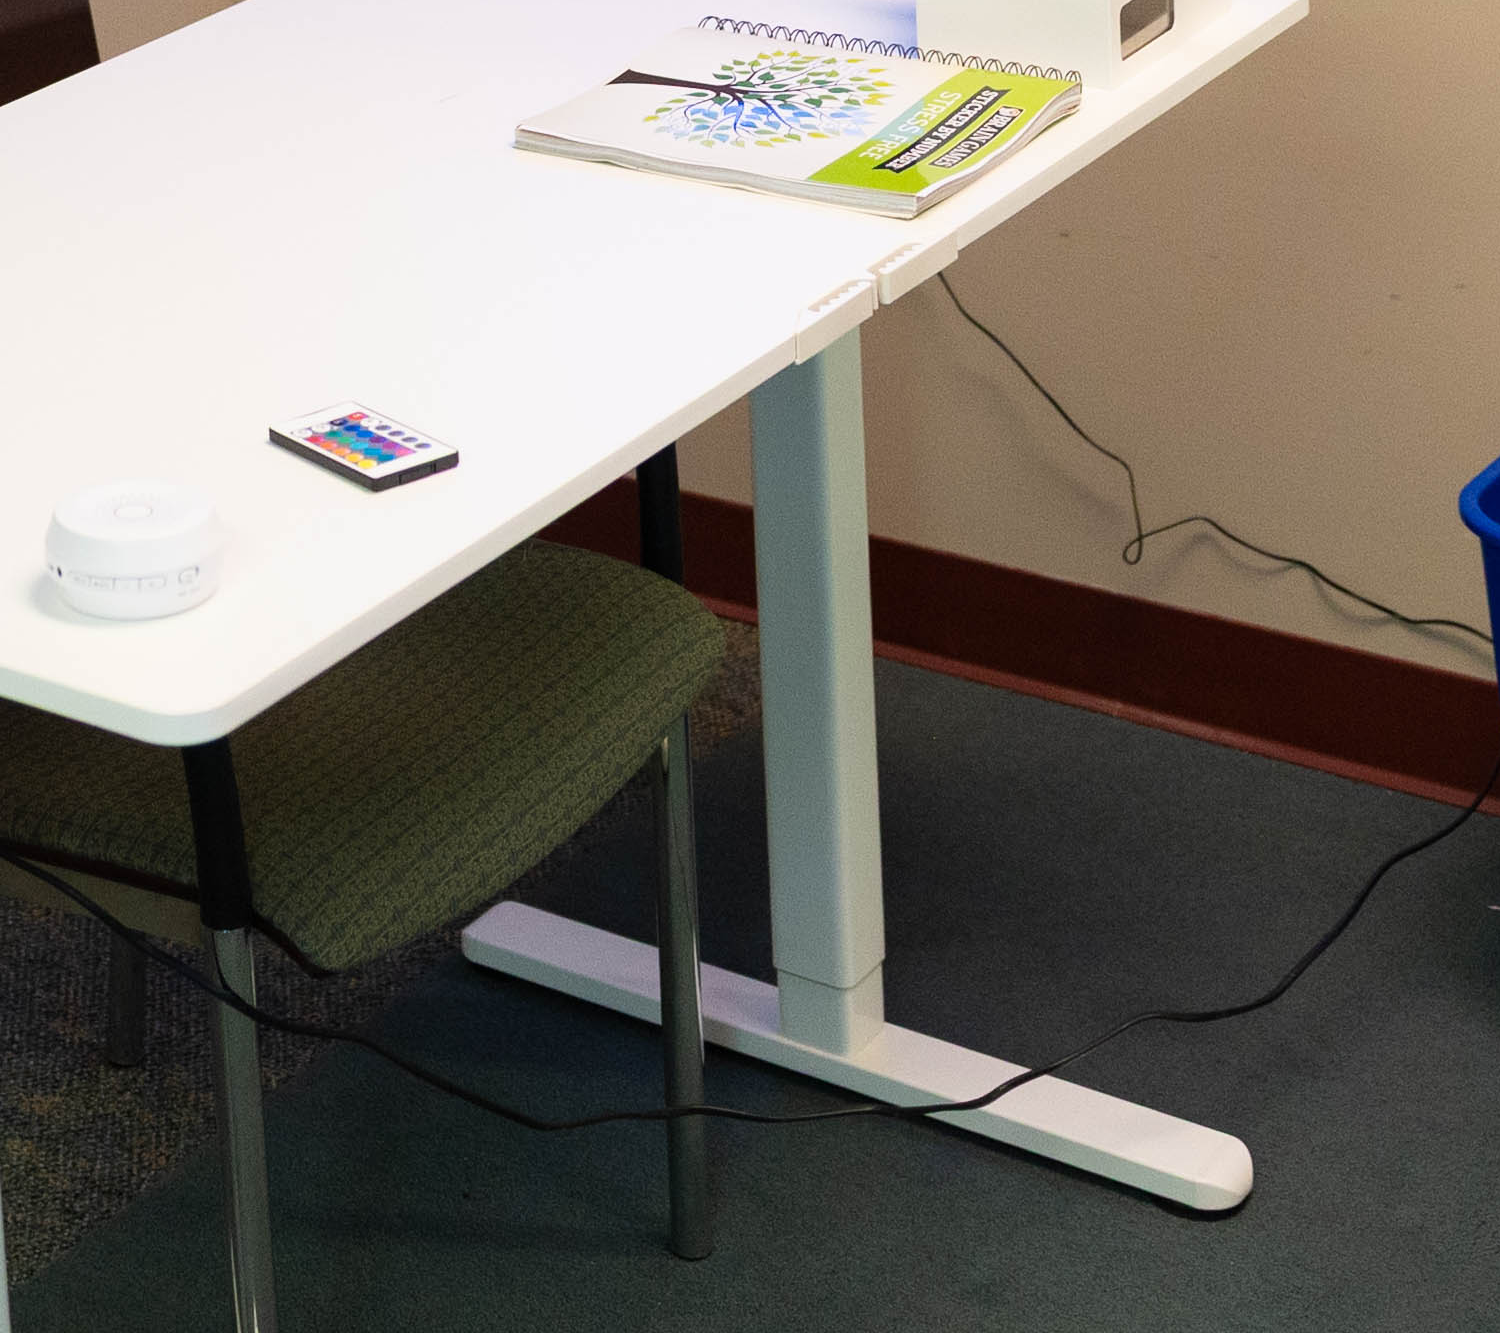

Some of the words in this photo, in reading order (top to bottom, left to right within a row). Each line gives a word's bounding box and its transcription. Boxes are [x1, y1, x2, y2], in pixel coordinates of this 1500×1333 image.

[898, 91, 963, 134] STRESS
[955, 90, 999, 126] STICKER
[933, 121, 956, 143] BY
[978, 115, 1013, 146] BRAIN
[858, 133, 907, 160] FREE
